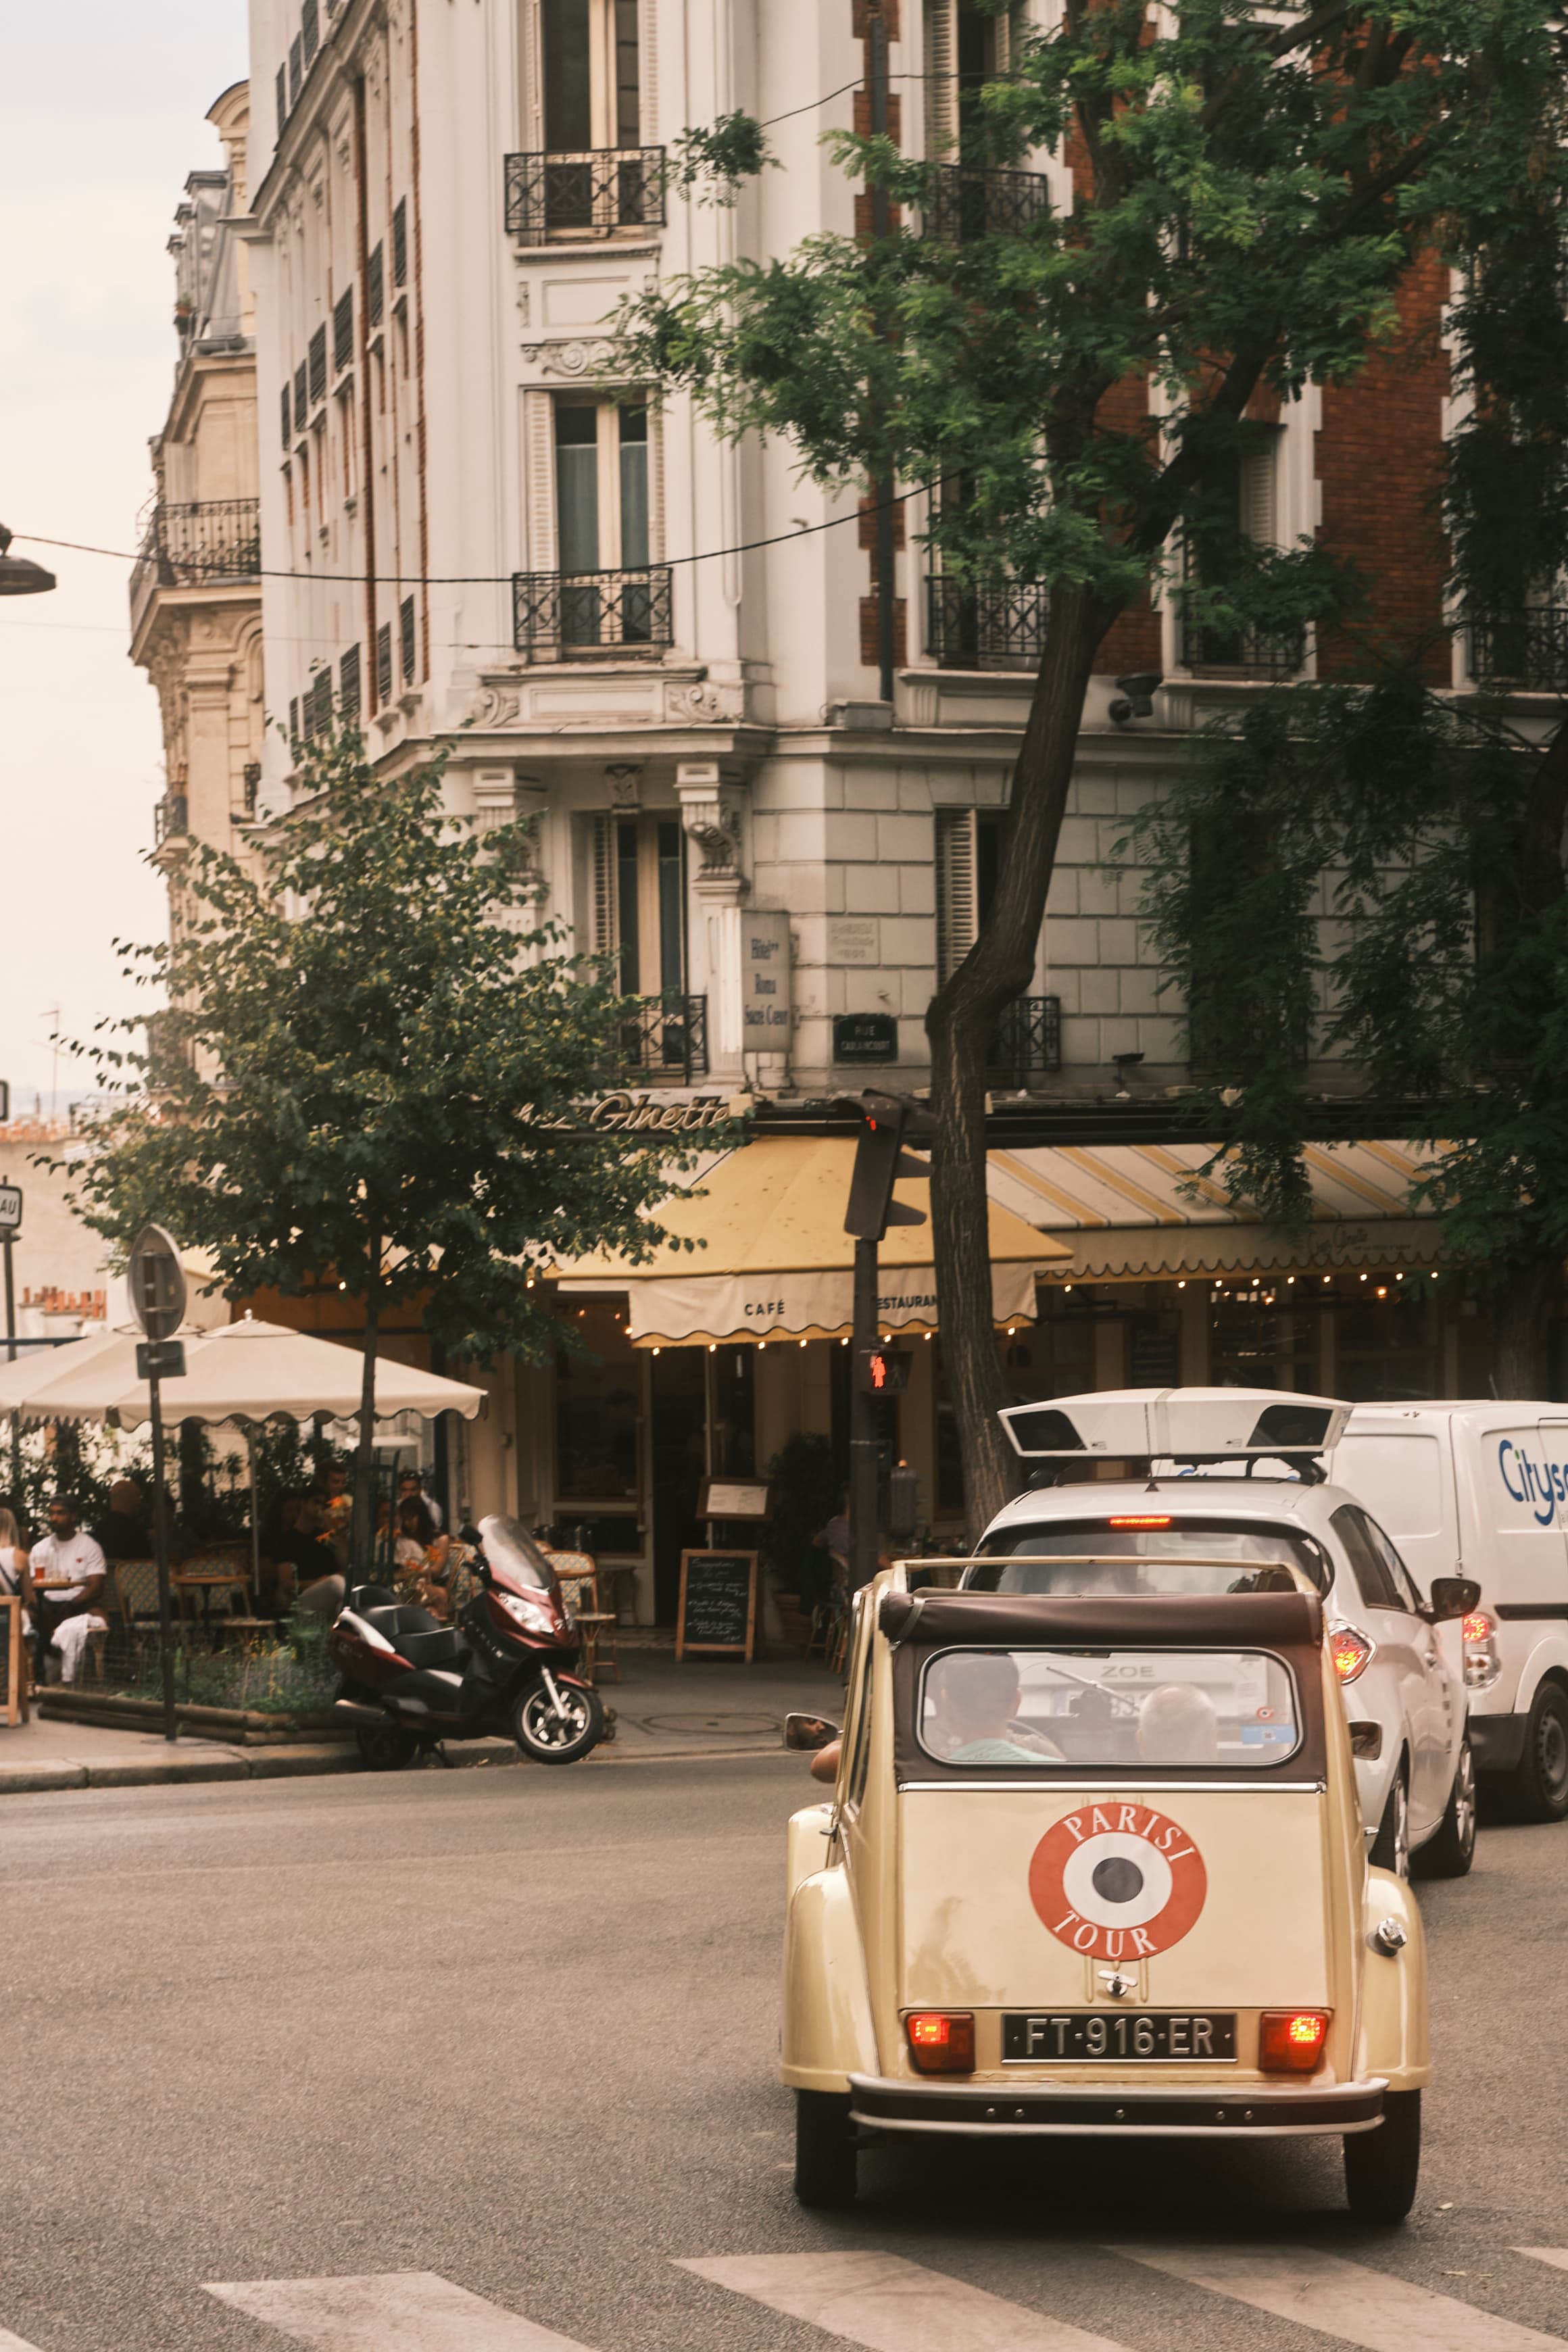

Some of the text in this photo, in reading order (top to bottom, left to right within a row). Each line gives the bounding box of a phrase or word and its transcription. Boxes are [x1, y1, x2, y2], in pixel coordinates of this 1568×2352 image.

[589, 1090, 733, 1132] Ginette
[0, 1198, 17, 1215] AU
[744, 1298, 785, 1316] CAFÉ
[877, 1294, 937, 1310] ESTAURAN
[1101, 1666, 1155, 1677] ZOE
[1052, 1910, 1158, 1958] TOUR
